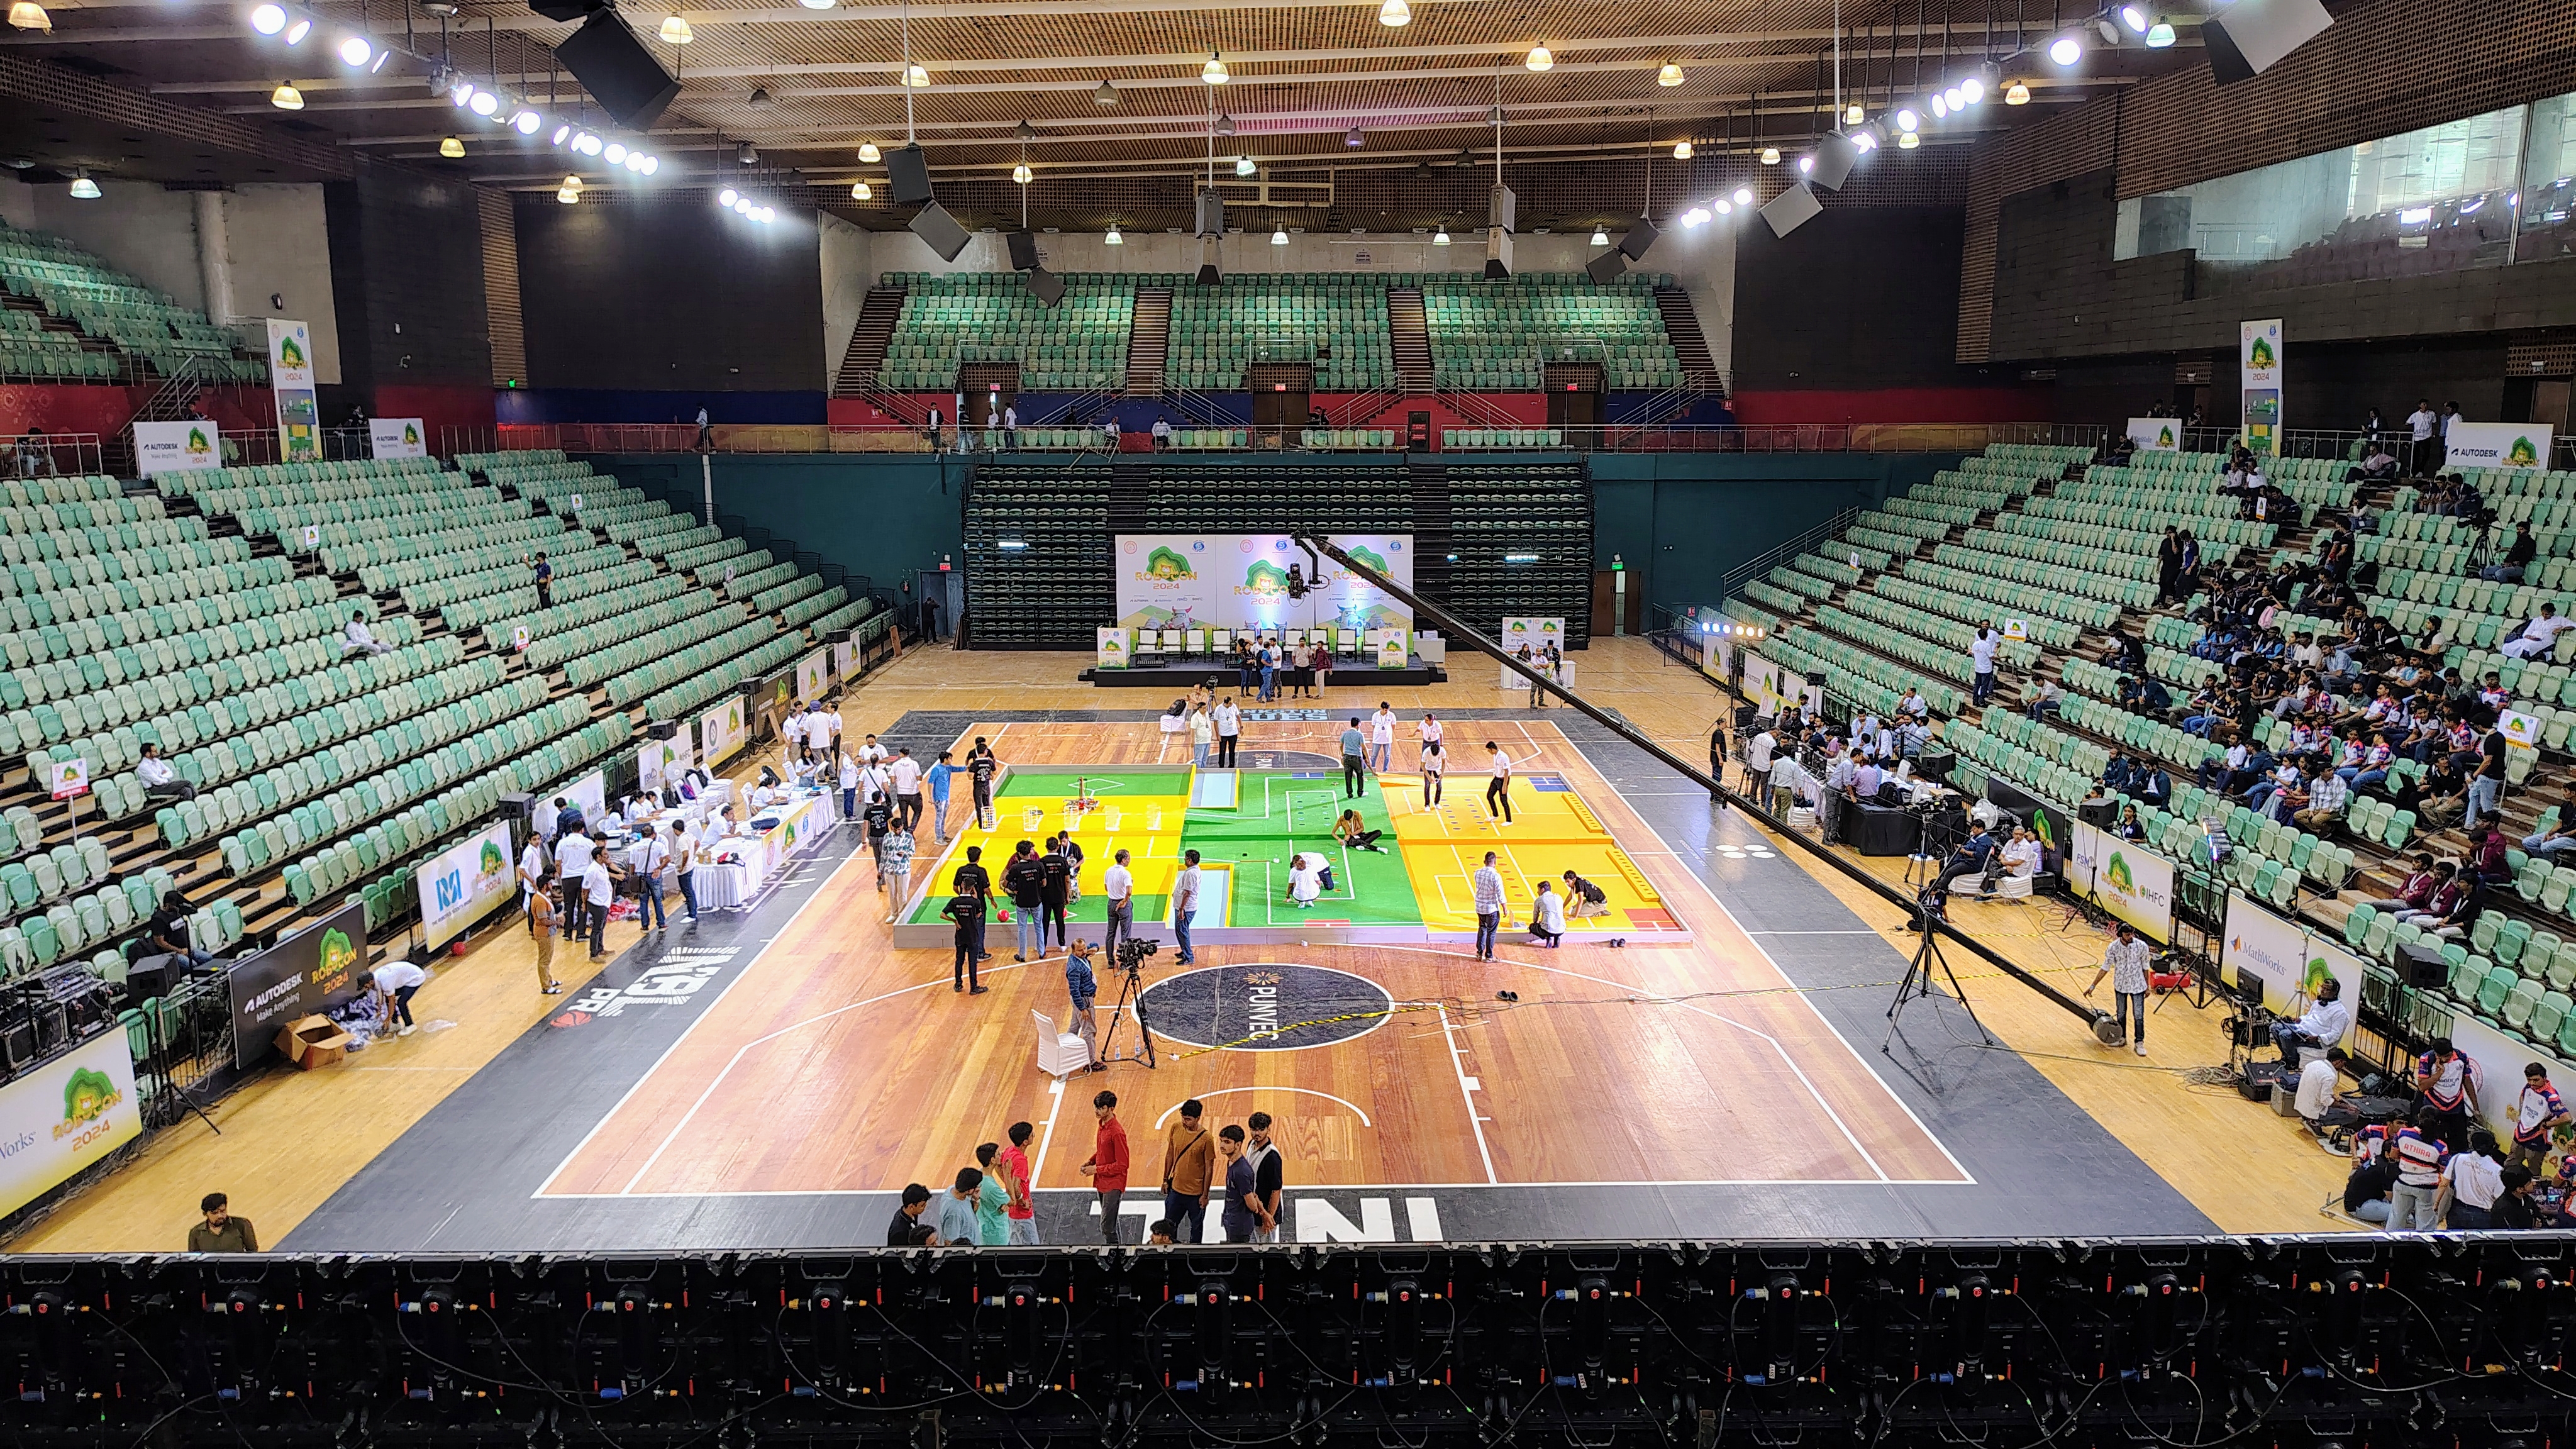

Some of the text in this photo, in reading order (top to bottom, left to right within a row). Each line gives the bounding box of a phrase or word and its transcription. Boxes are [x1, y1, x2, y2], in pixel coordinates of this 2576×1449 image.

[2252, 372, 2270, 380] 2024
[2460, 448, 2499, 457] AUTODESK
[1135, 571, 1197, 581] ROBOCON
[1234, 586, 1289, 595] ROBOCO
[485, 877, 501, 894] 2024
[2101, 870, 2136, 899] ROBOCON
[2146, 887, 2165, 908] IHFC
[2108, 890, 2128, 908] 2024
[311, 947, 358, 985] ROBOCON
[2243, 941, 2286, 976] MathWorks
[255, 970, 304, 1008] AUTODESK
[323, 970, 350, 996] 2024
[255, 991, 301, 1024] Make Anything
[1249, 987, 1279, 1041] PUNVEC
[52, 1089, 123, 1141] ROBOCON
[72, 1119, 111, 1152] 2024
[2404, 1143, 2431, 1158] ATHIRA
